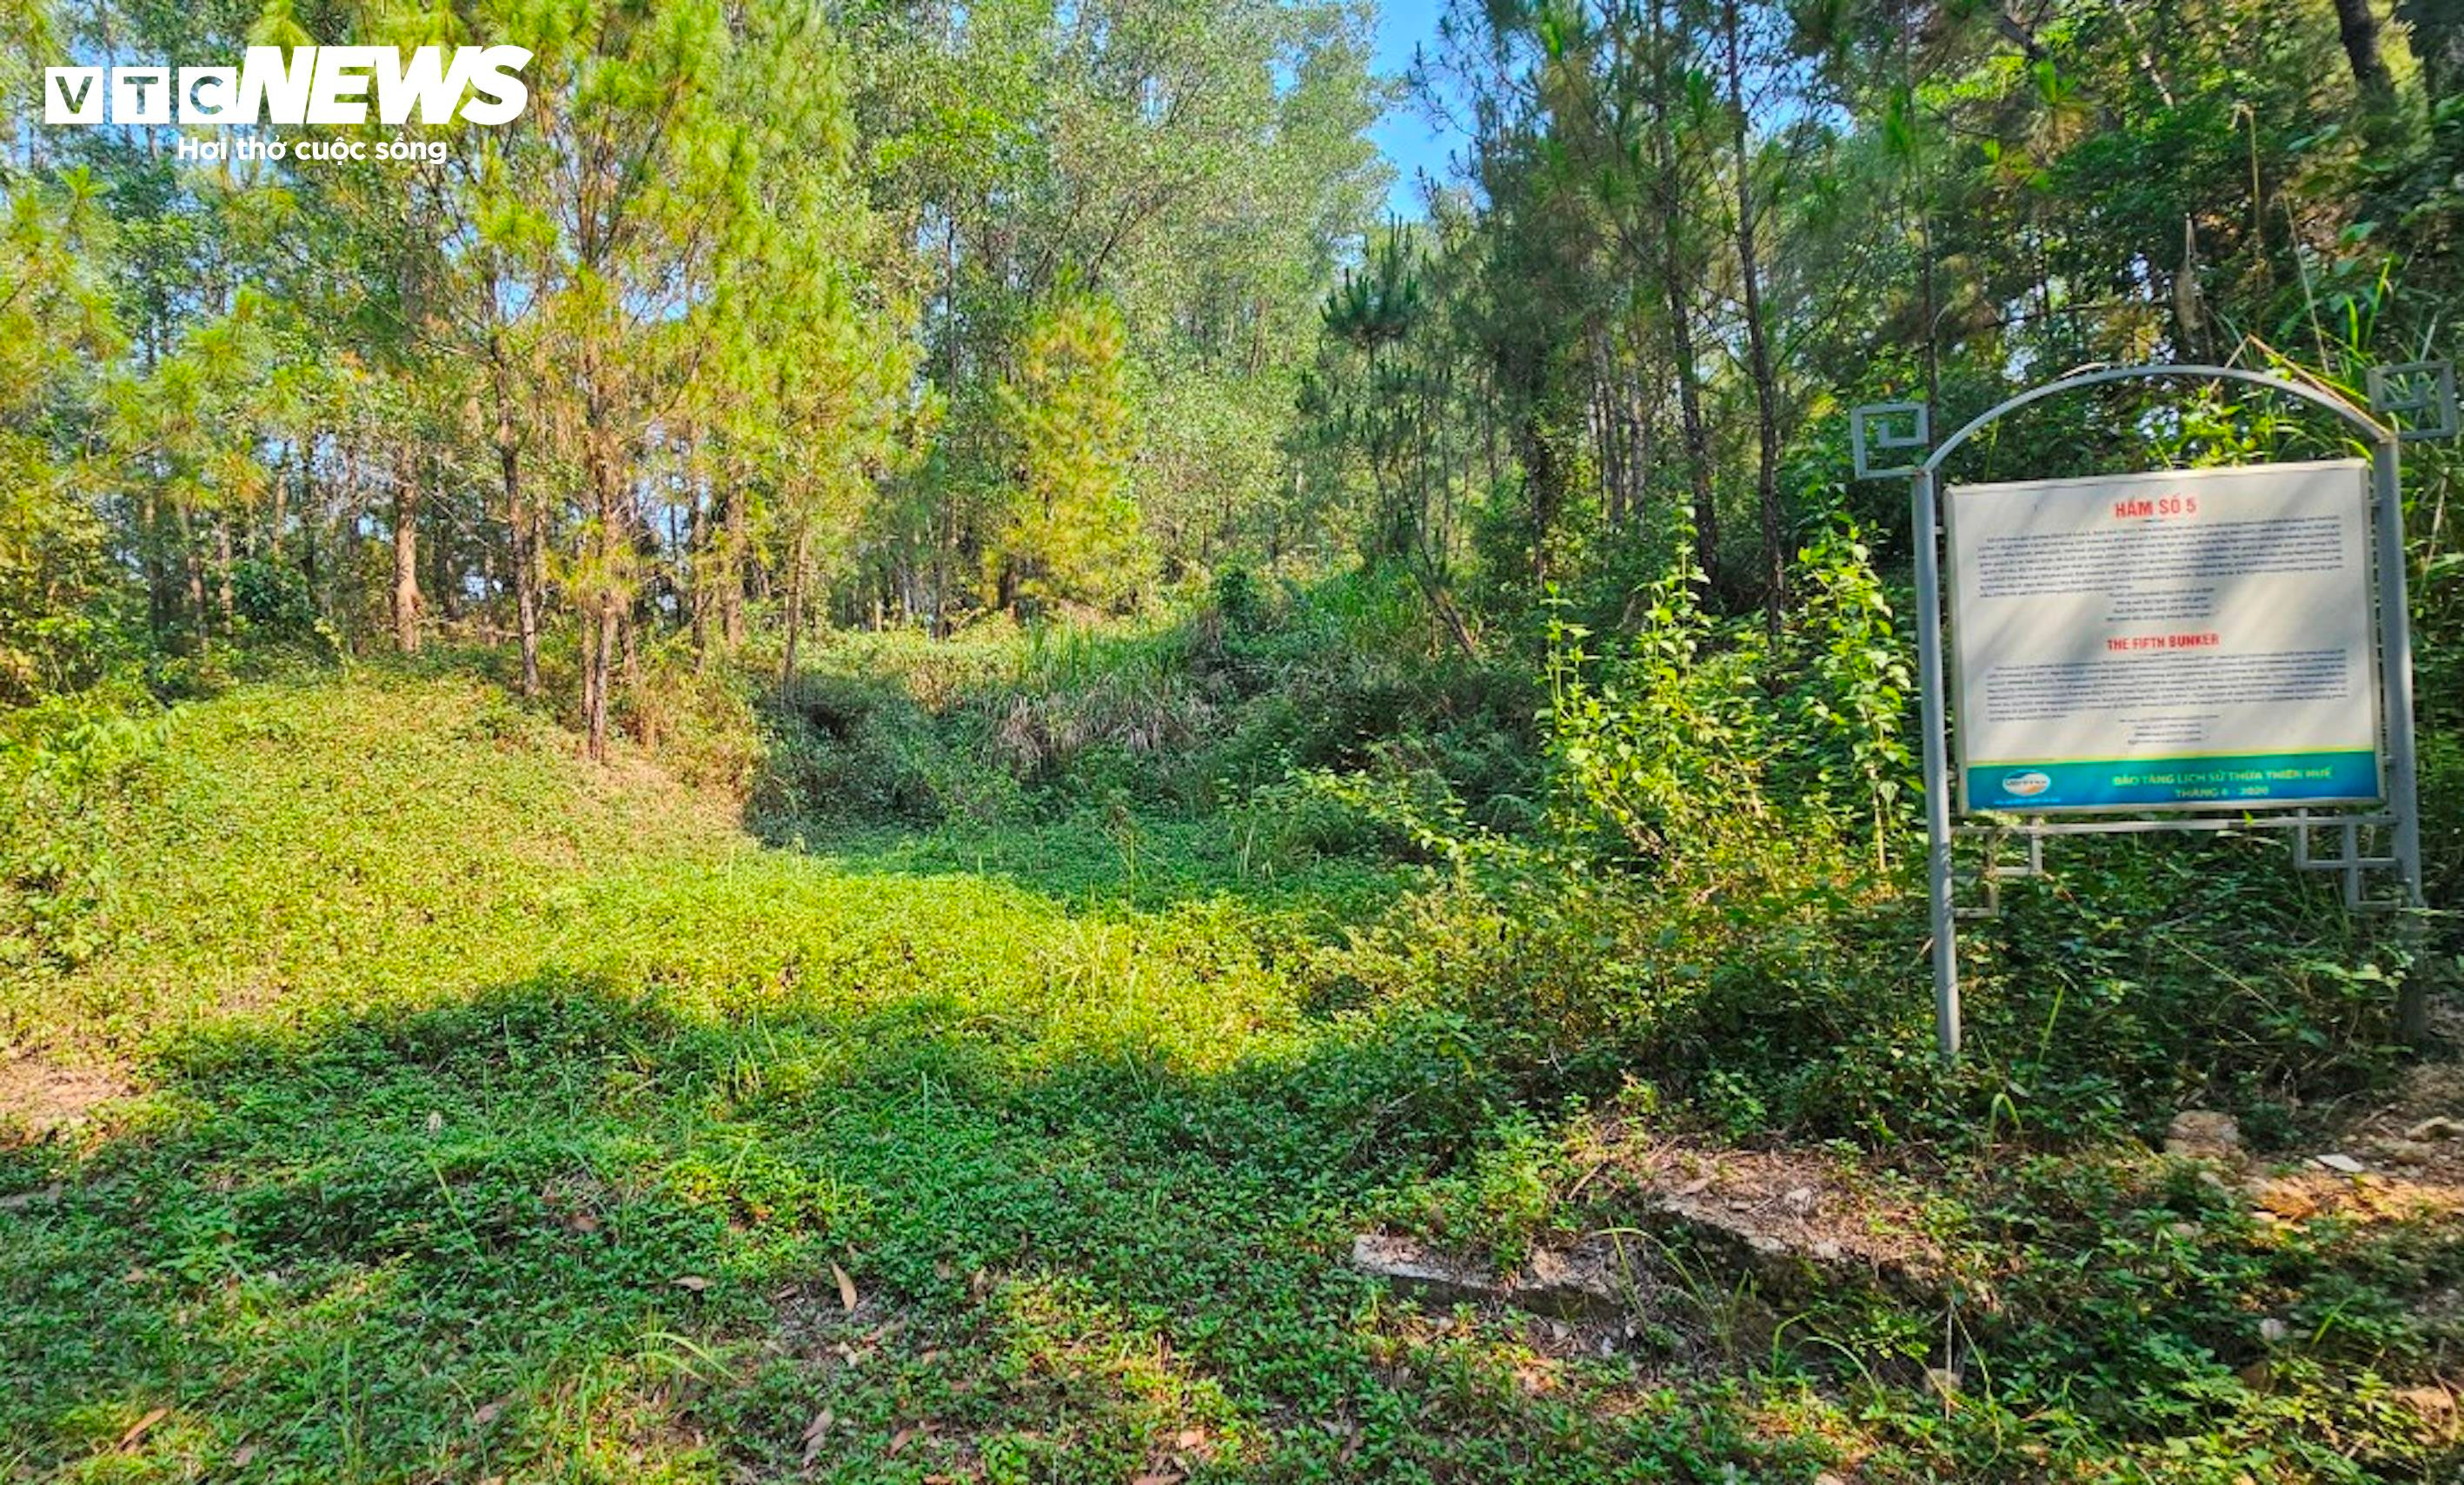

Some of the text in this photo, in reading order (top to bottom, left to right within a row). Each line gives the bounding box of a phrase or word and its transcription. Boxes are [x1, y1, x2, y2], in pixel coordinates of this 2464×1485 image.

[2185, 497, 2197, 513] 5
[2107, 633, 2220, 651] THE FIFTH BUNKER
